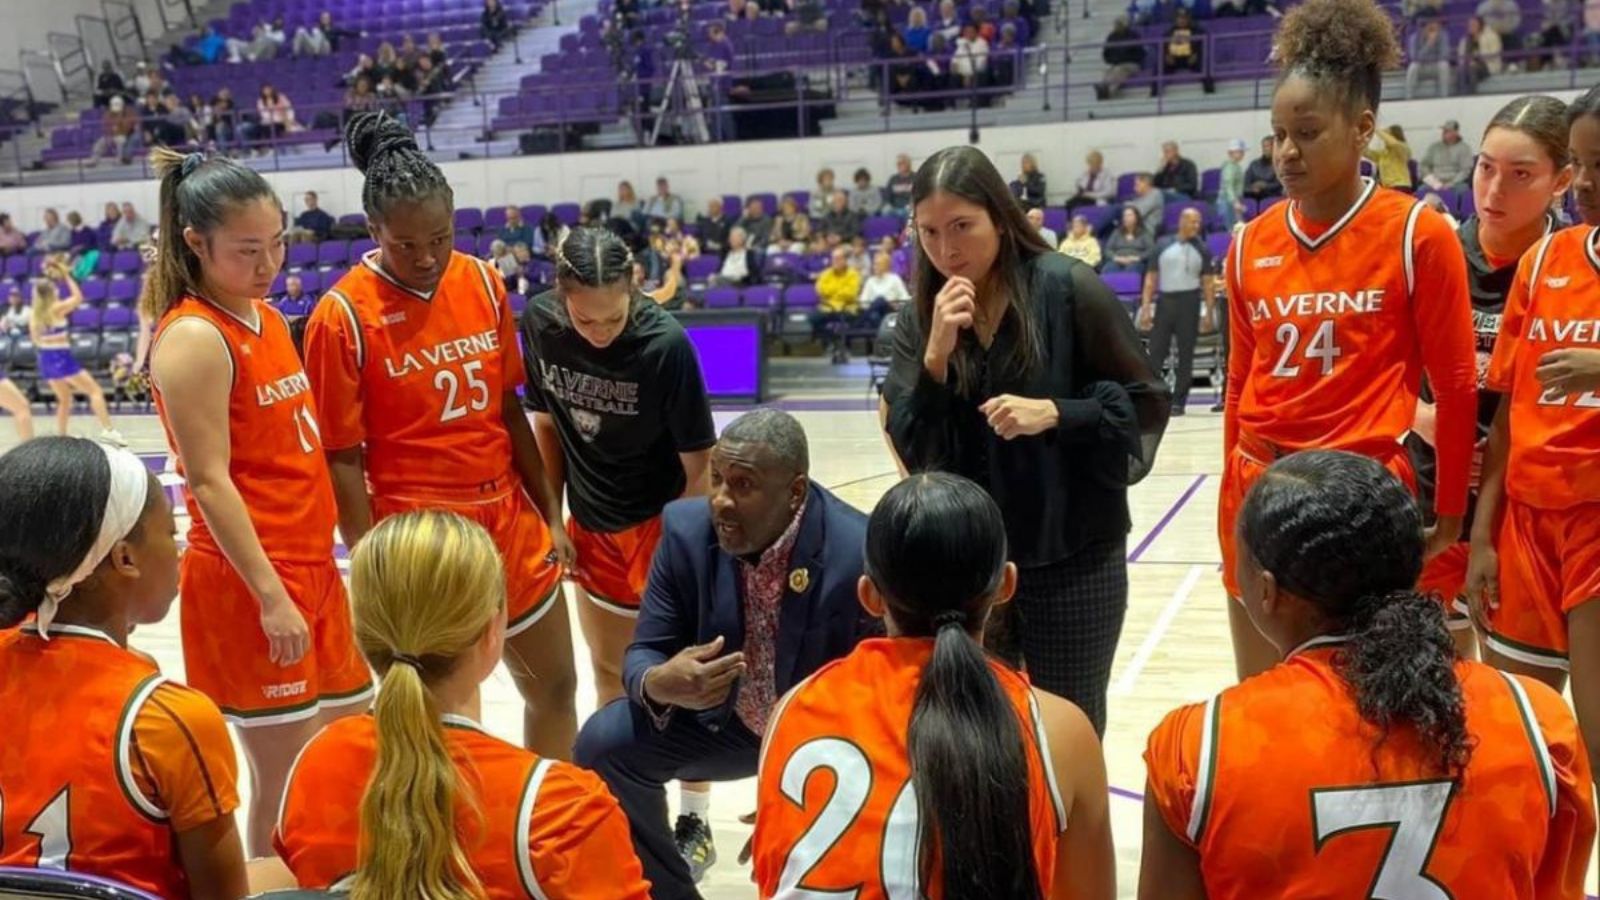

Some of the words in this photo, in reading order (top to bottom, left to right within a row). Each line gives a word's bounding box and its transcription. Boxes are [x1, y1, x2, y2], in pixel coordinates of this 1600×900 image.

[1274, 290, 1385, 317] VERNE
[385, 353, 424, 377] LA
[420, 329, 499, 366] VERNE
[1271, 319, 1341, 377] 24
[434, 360, 489, 422] 25
[561, 367, 639, 403] VERNE
